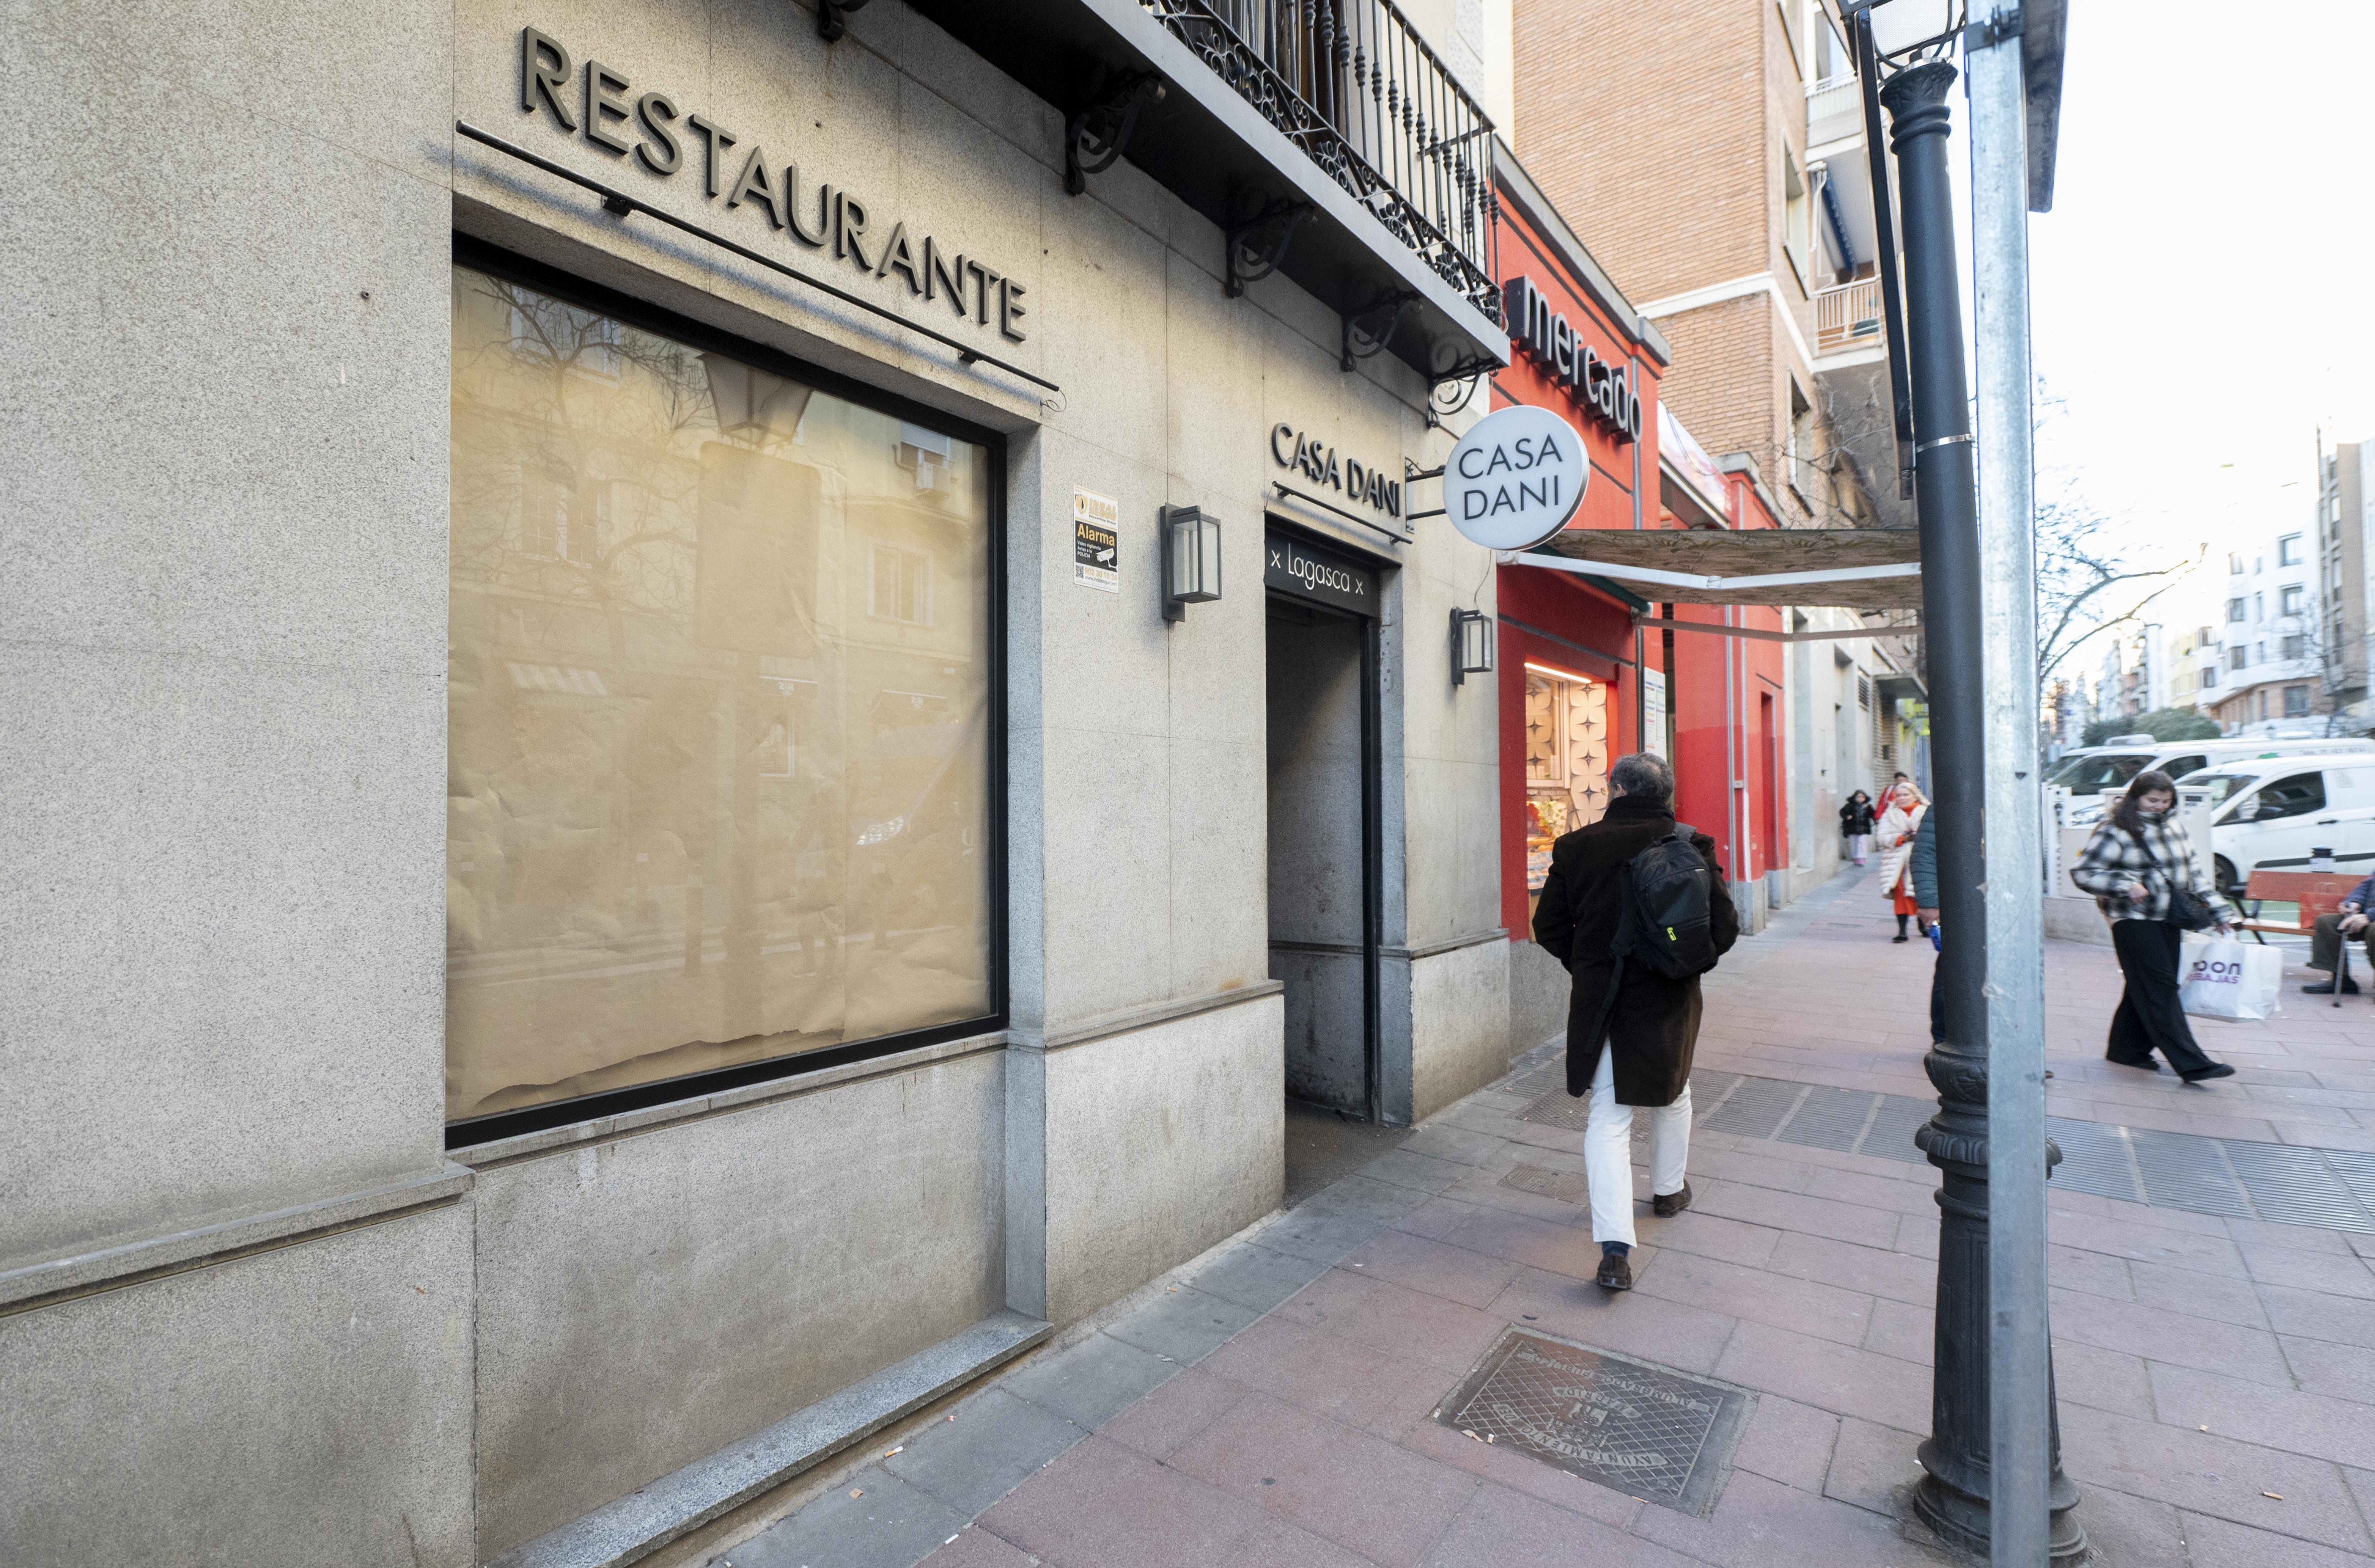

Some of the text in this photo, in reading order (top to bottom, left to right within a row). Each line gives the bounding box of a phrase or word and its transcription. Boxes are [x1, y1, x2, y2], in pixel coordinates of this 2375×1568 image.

[522, 25, 1027, 342] RESTAURANTE
[1505, 275, 1642, 444] mercado
[1271, 422, 1400, 517] CASA DANI
[1459, 433, 1563, 479] CASA
[1464, 475, 1559, 520] DANI
[1077, 523, 1115, 547] Alarma
[1085, 567, 1095, 576] 902
[1288, 543, 1350, 592] Lagasca
[1567, 1387, 1633, 1413] MADRID
[1604, 1375, 1692, 1405] ALUMBRADO
[1498, 1408, 1653, 1466] AYUNTAMIENTO DE
